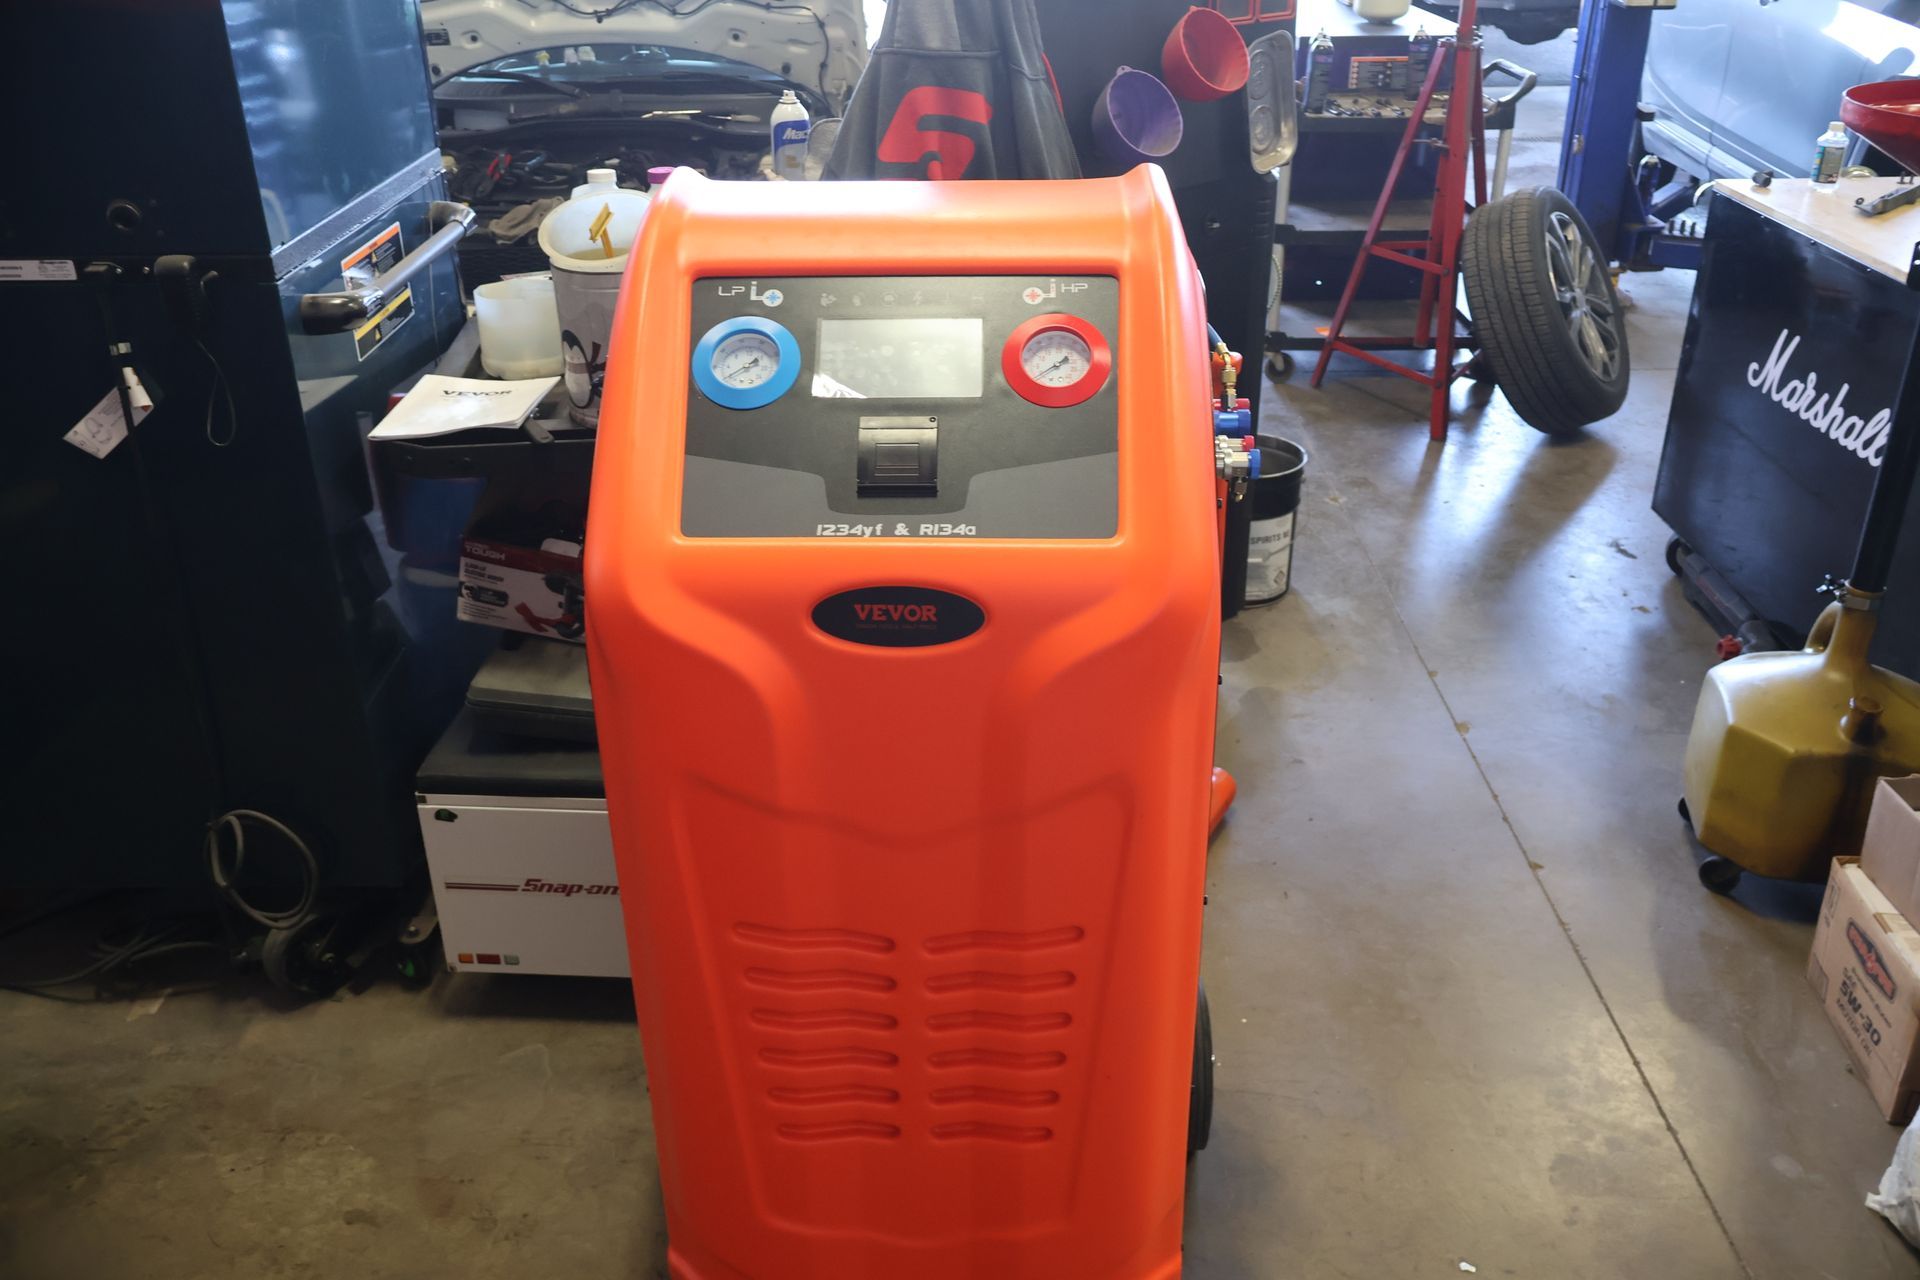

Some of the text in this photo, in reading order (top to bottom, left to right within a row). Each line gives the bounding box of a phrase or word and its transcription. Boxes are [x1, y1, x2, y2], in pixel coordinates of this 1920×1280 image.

[718, 285, 746, 297] LP
[1060, 282, 1089, 293] HP
[816, 522, 977, 538] 1234yf & R134a
[465, 545, 506, 560] TOUGH
[853, 603, 938, 623] VEVOR
[1839, 981, 1882, 1047] 5W-30
